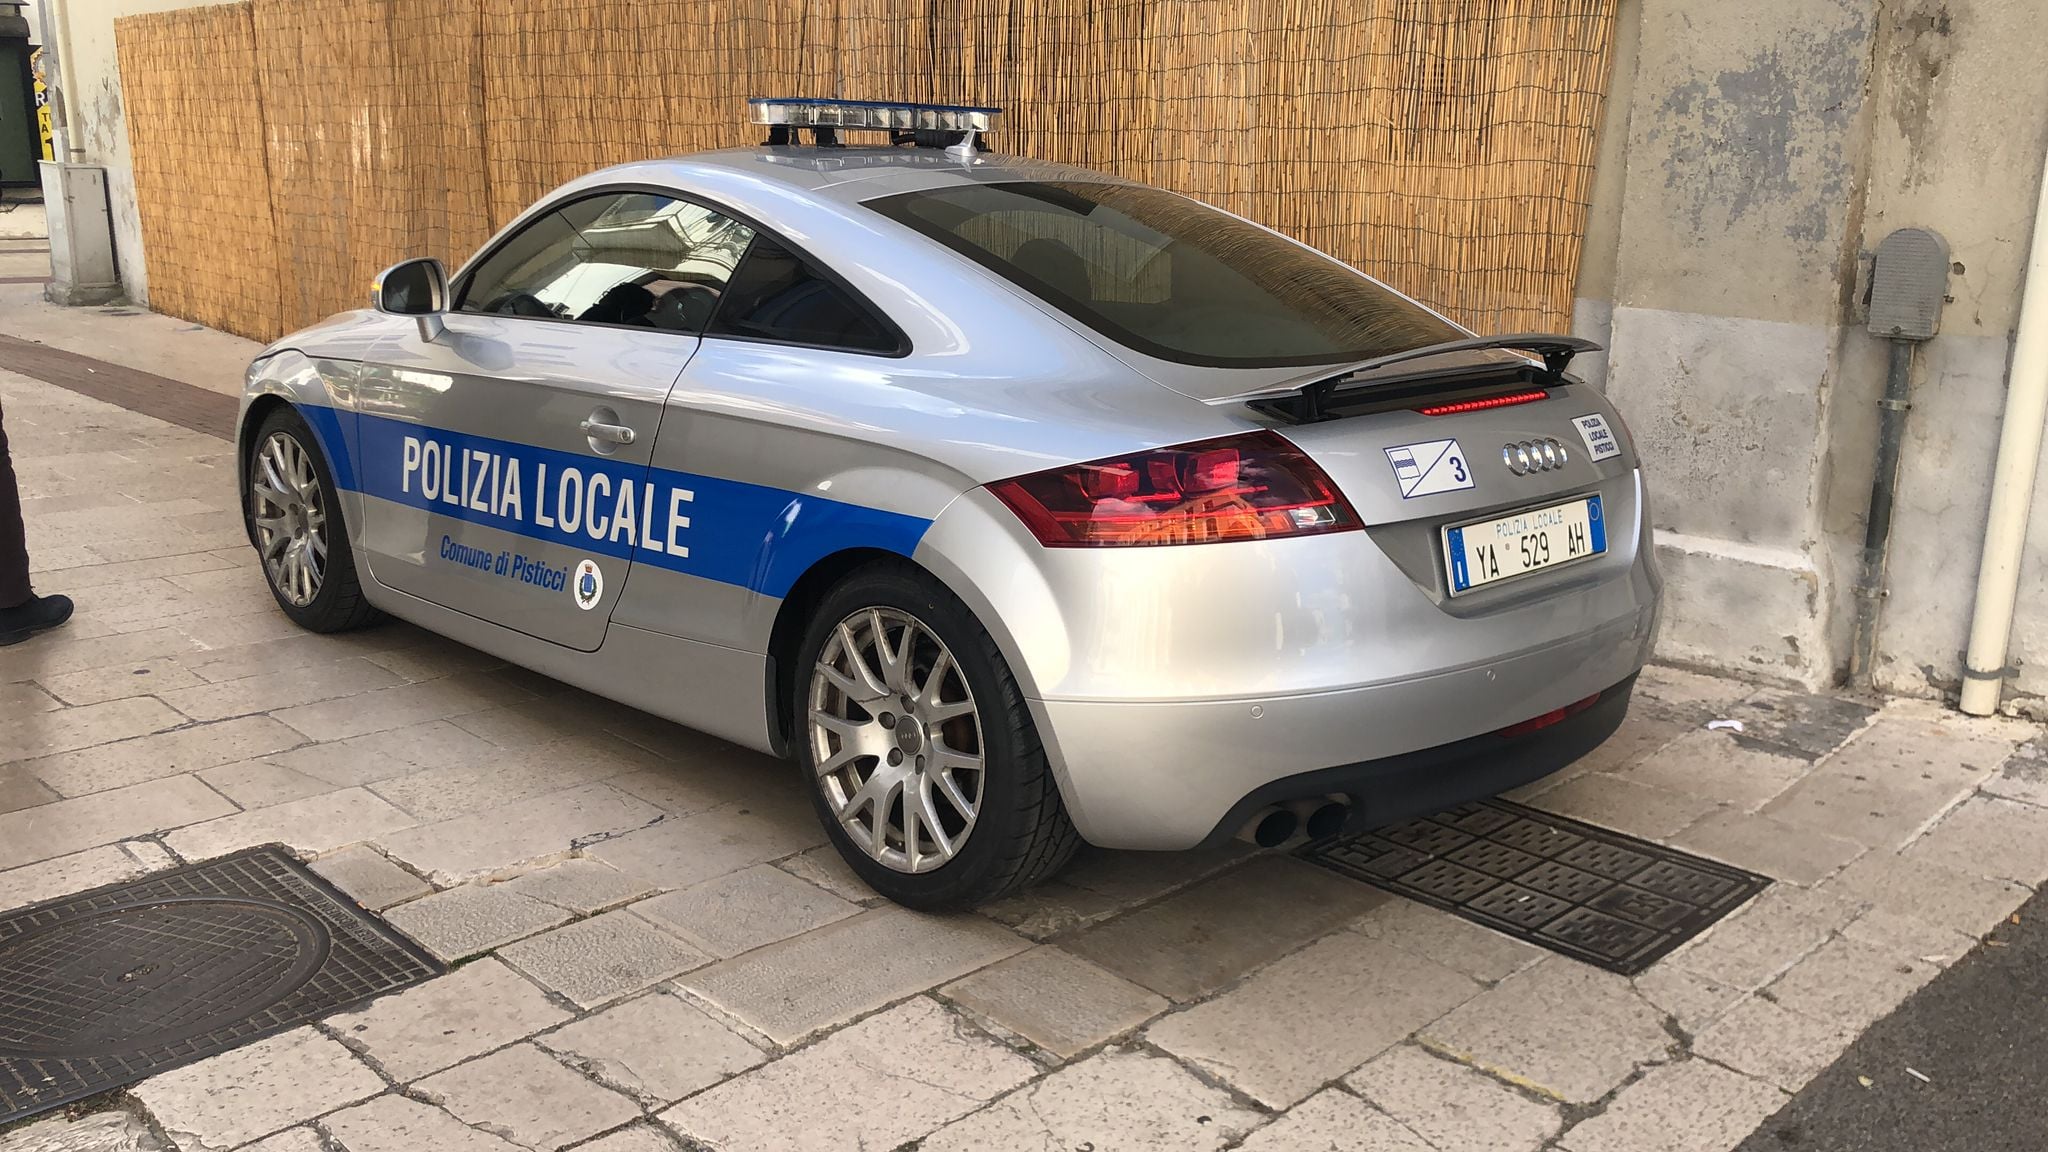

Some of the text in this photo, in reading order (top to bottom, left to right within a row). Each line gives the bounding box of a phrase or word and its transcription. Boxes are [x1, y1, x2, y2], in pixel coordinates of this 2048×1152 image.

[1581, 417, 1602, 429] POLIZIA
[1588, 429, 1609, 441] LOCALE
[1449, 456, 1467, 482] 3
[402, 436, 695, 558] POLIZIA LOCALE
[1496, 509, 1563, 539] POLIZIA LOCALE
[440, 534, 568, 592] Comune di Pisticci
[1476, 521, 1585, 579] YA 529 AH
